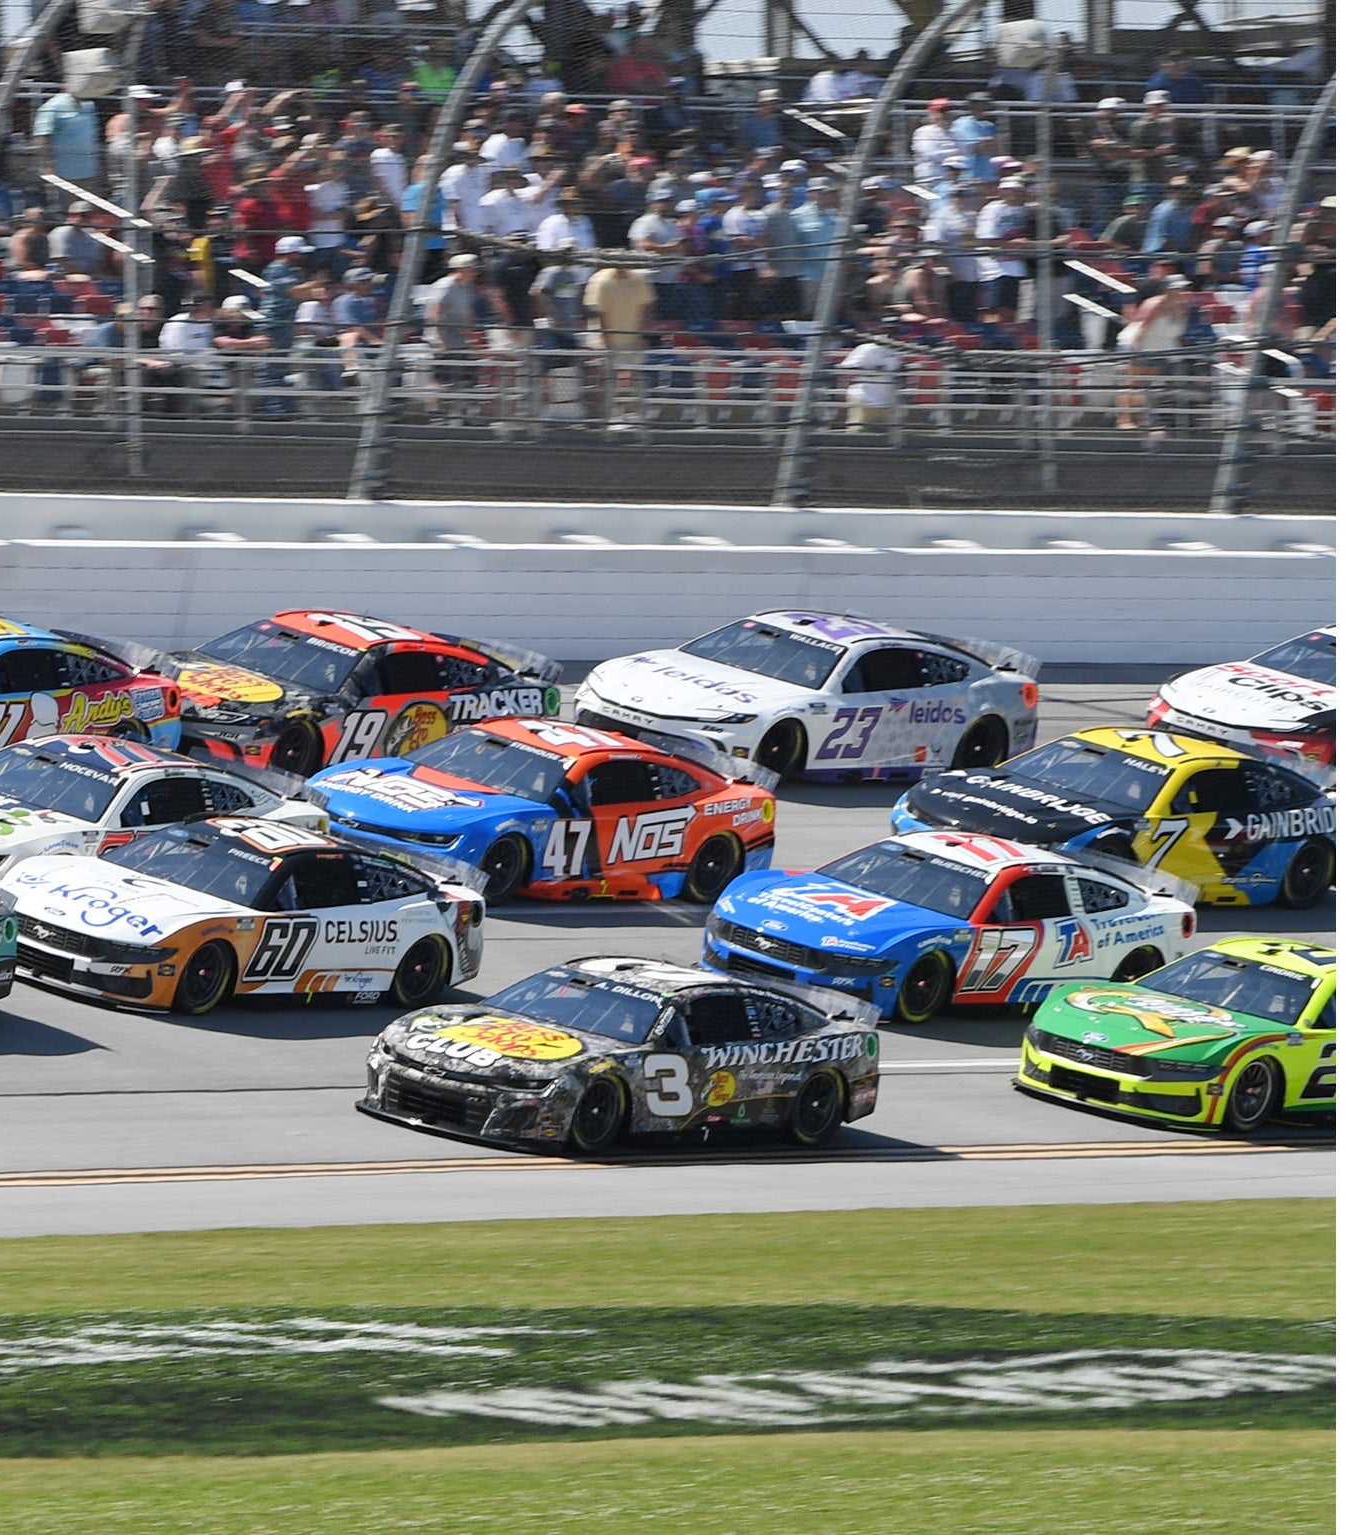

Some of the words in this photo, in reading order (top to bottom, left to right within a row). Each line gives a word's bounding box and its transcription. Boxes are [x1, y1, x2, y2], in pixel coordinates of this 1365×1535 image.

[306, 636, 360, 658] BRISCOE
[789, 632, 842, 653] WALLACE
[651, 665, 759, 705] leidos
[1215, 664, 1336, 697] Sport
[1227, 676, 1330, 711] Clips
[62, 690, 134, 735] Andy's
[449, 687, 545, 721] TRACKER
[601, 706, 655, 725] CAMRY
[909, 700, 967, 725] leidos
[330, 710, 387, 766] 19
[814, 705, 884, 760] 23
[1176, 716, 1229, 736] CAMRY
[60, 761, 118, 787] HOCEVAR
[1123, 757, 1171, 777] HALEY
[323, 767, 486, 812] NOS
[966, 775, 1114, 825] GAINBRIDGE
[703, 797, 753, 816] ENERGY
[732, 808, 764, 827] DRINK
[962, 795, 1039, 825] gainbridge.io
[542, 820, 592, 878] 47
[606, 805, 699, 865] NOS
[1143, 818, 1190, 873] 7
[227, 847, 272, 866] PREECE
[48, 882, 164, 938] Kroger
[325, 920, 398, 943] CELSIUS
[1053, 917, 1095, 969] TA
[1096, 933, 1110, 950] of
[1111, 925, 1165, 947] America
[242, 916, 320, 982] 60
[364, 946, 381, 955] LIVE
[959, 925, 1038, 994] 17
[1258, 964, 1308, 981] CINDRIC
[354, 992, 382, 1001] FORD
[594, 980, 608, 991] A.
[611, 985, 663, 1009] DILLON
[405, 1032, 504, 1067] CLUB
[701, 1032, 865, 1070] WINCHESTER
[643, 1053, 694, 1117] 3
